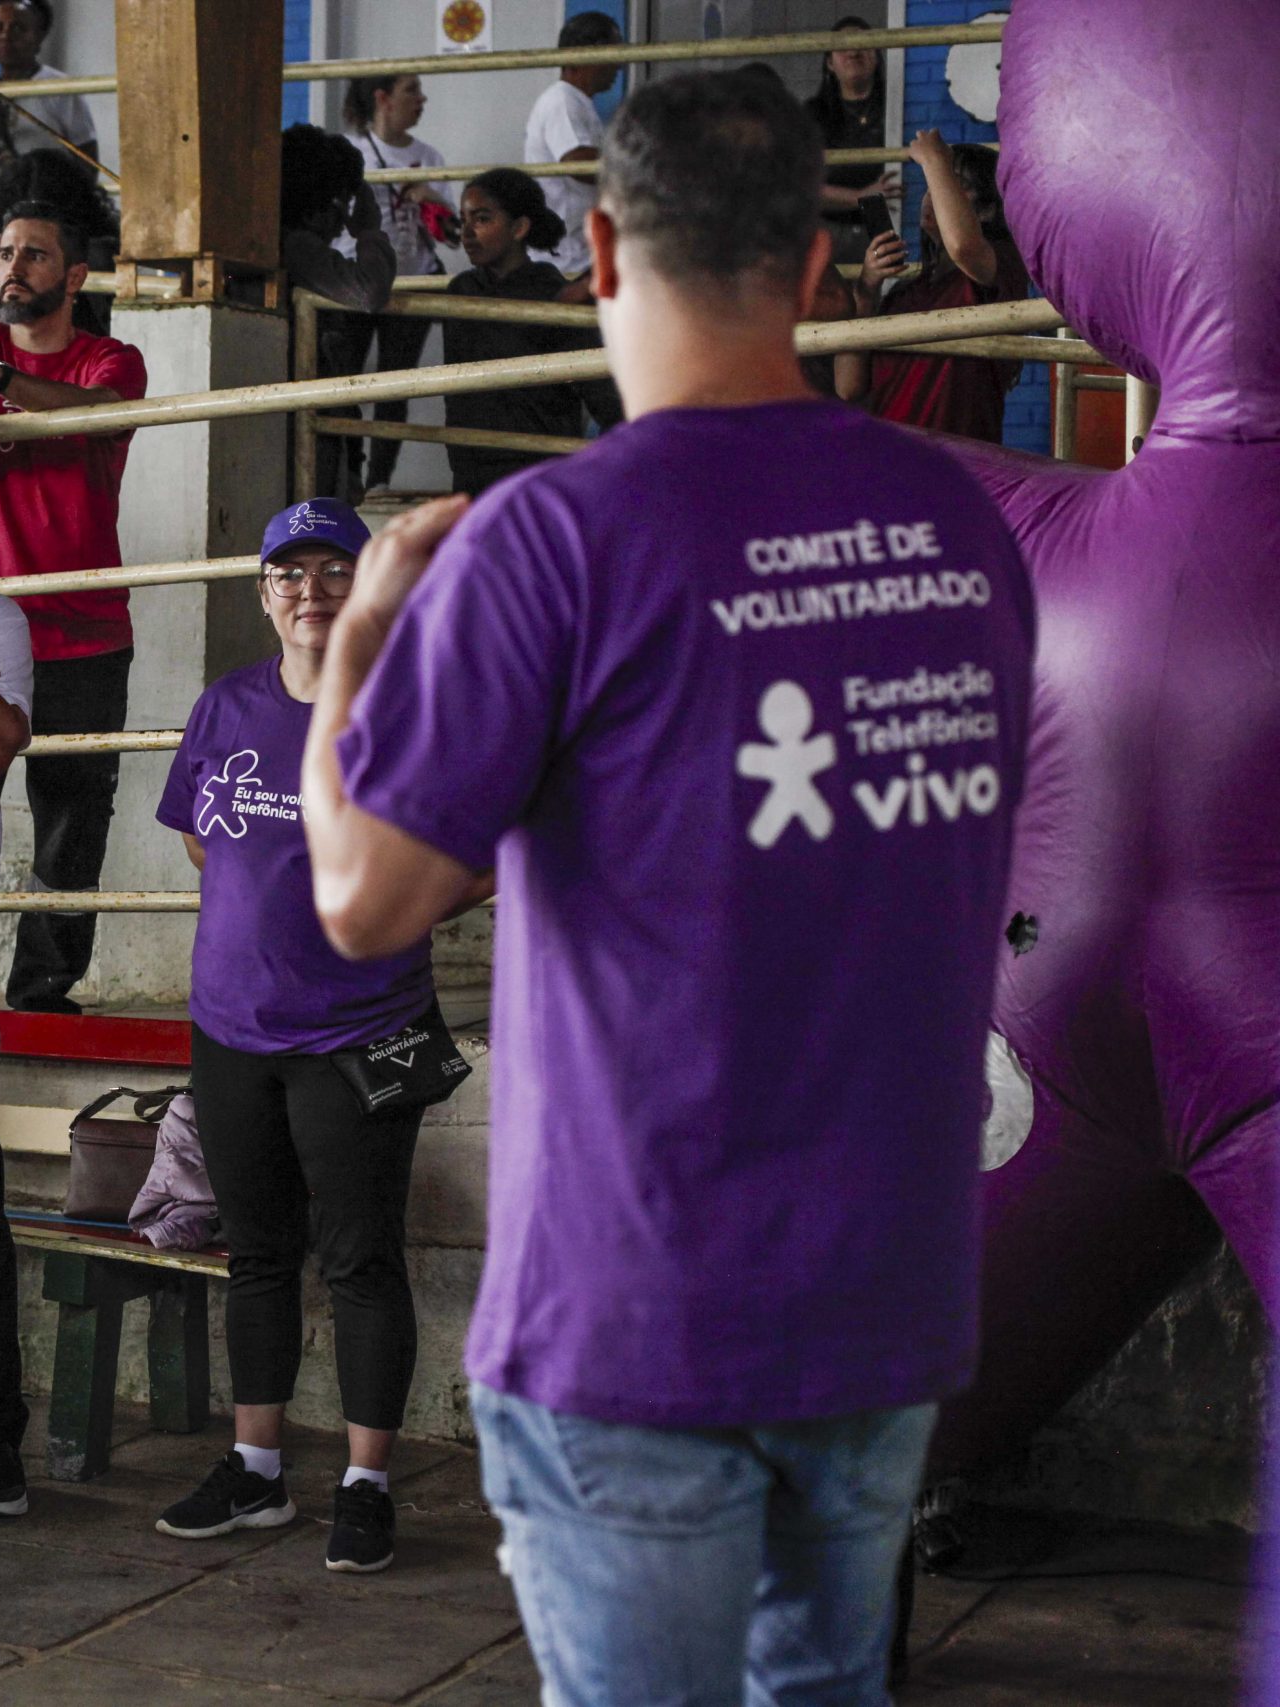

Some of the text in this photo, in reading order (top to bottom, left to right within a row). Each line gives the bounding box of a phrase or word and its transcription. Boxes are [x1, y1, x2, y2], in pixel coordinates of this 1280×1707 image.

[745, 519, 942, 575] COMITÊ DE
[711, 570, 991, 635] VOLUNTARIADO
[842, 661, 994, 713] Fundação
[231, 801, 297, 820] Telefônica
[235, 786, 252, 799] Eu
[254, 790, 278, 802] sou
[852, 752, 1000, 831] vivo
[367, 1031, 430, 1062] VOLUNTÁRIOS
